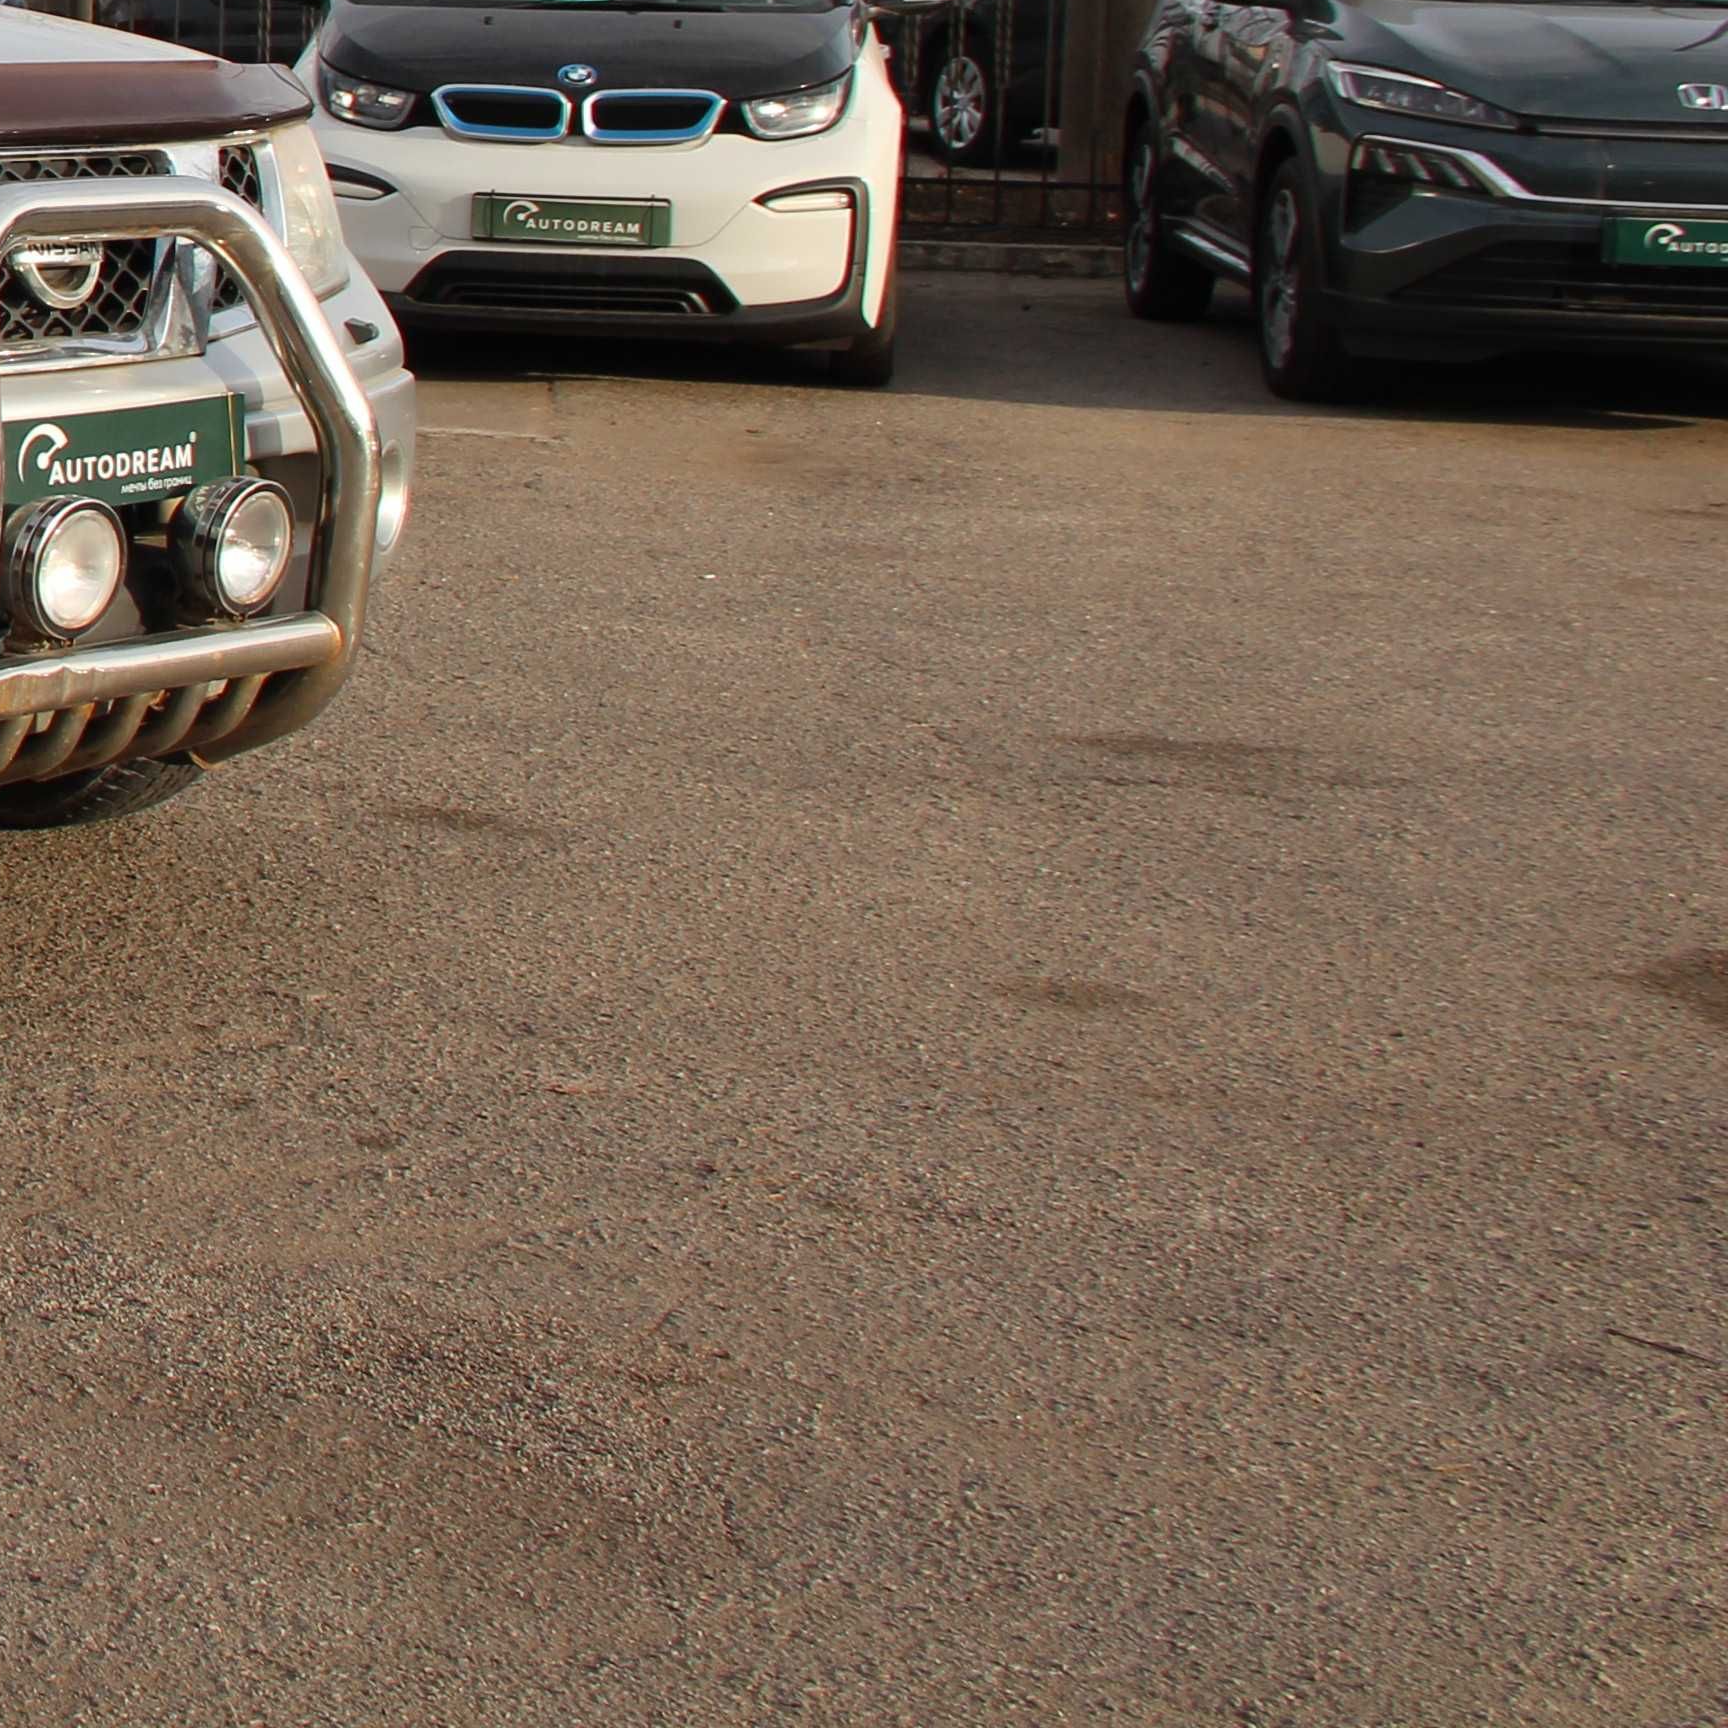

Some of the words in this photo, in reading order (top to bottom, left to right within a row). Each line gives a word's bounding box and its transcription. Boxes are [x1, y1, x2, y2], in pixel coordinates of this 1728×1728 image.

[526, 219, 640, 234] AUTODREAM
[48, 443, 192, 486] AUTODREAM
[148, 477, 163, 490] без
